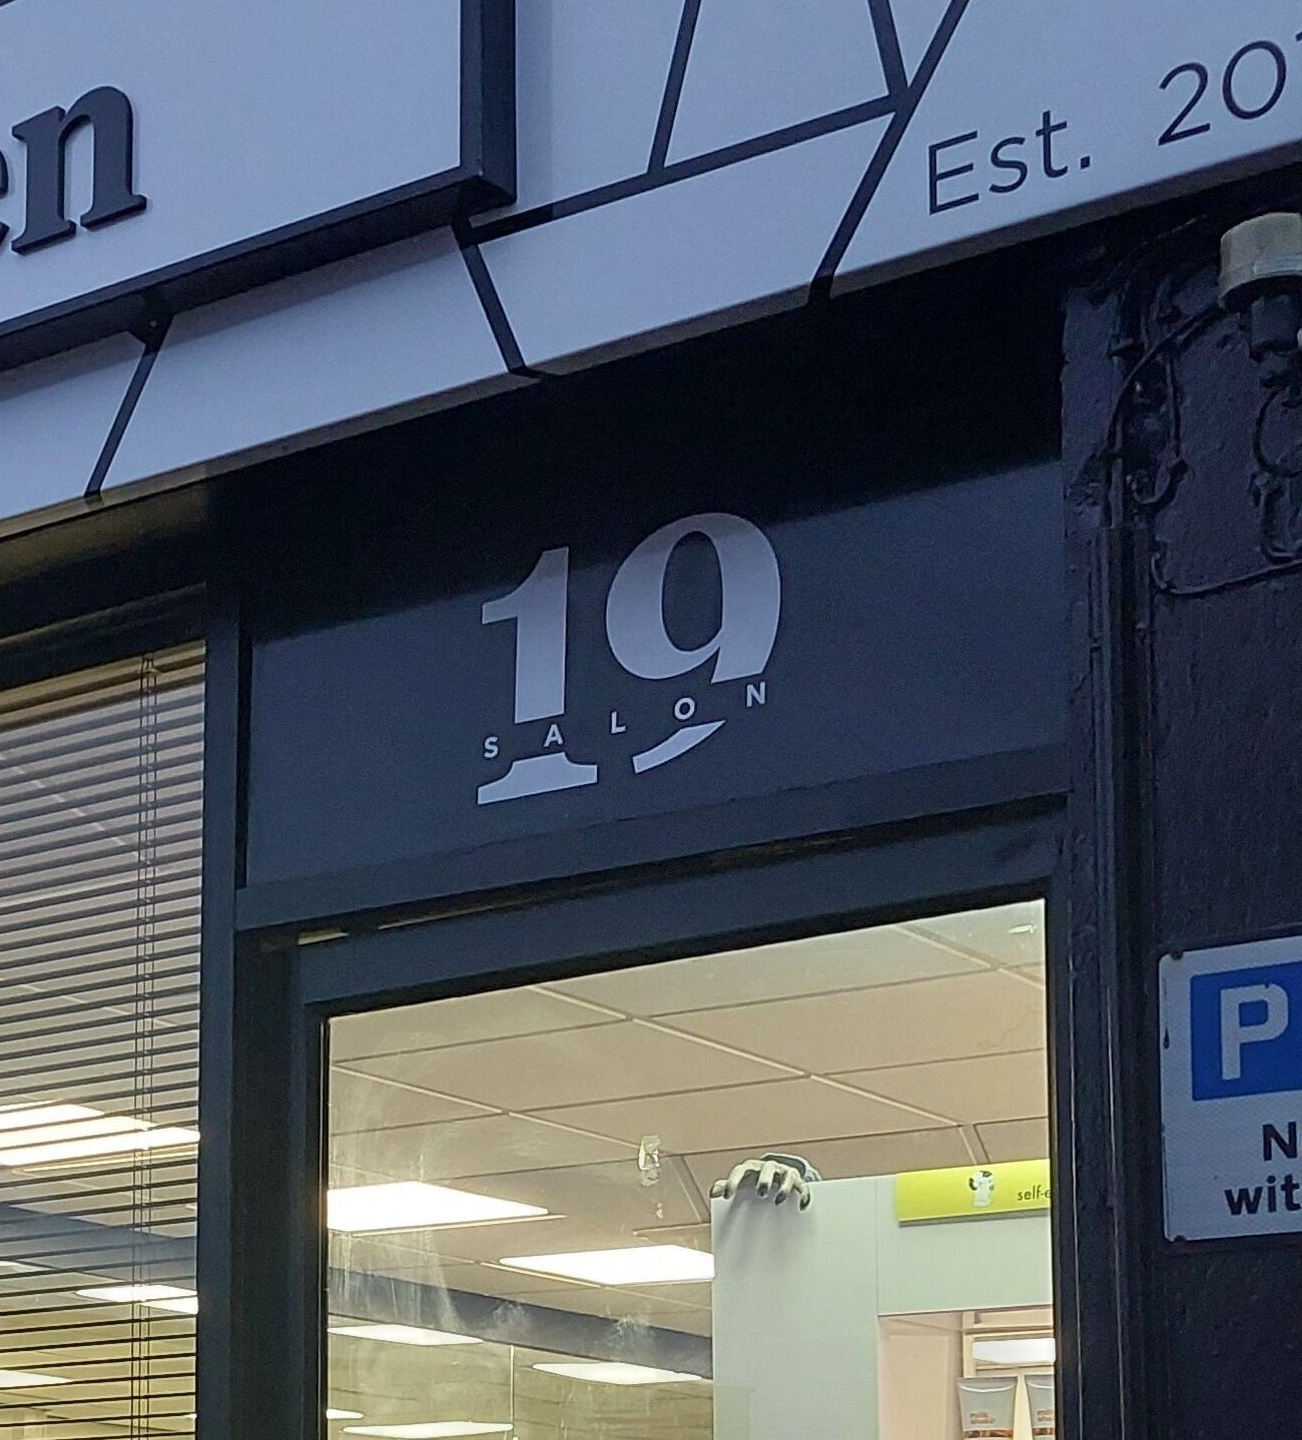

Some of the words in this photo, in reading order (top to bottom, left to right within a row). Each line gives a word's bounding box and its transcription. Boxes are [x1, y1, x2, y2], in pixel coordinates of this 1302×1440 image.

[928, 110, 1091, 215] Est.
[1157, 32, 1302, 147] 20
[477, 512, 781, 804] 19
[484, 681, 766, 759] SALON
[1220, 984, 1289, 1081] P
